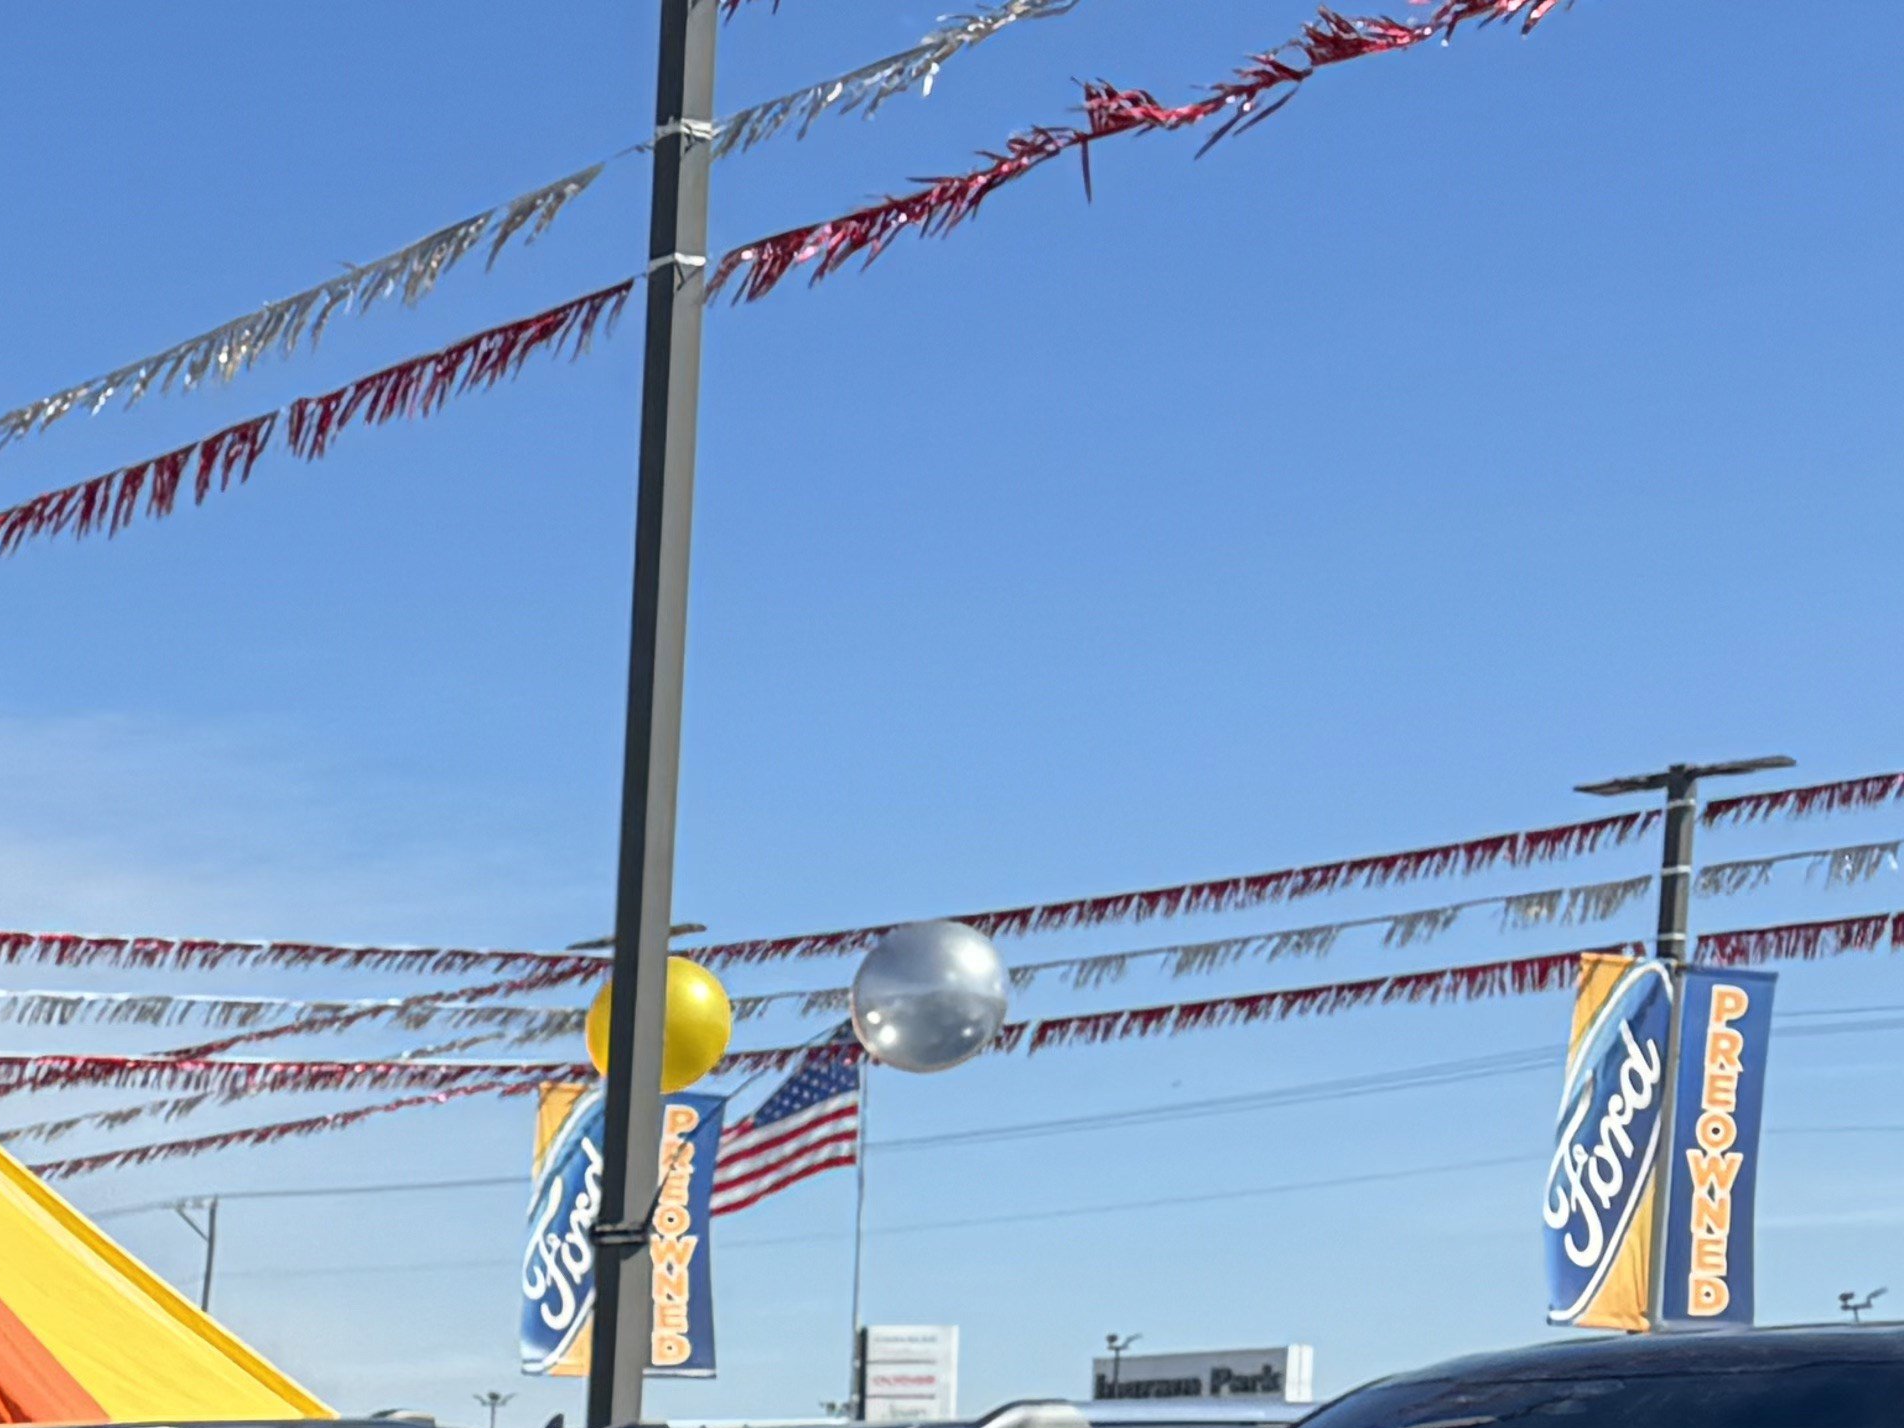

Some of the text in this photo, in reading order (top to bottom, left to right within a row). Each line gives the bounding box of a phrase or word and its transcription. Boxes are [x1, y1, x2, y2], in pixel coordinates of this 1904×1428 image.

[1543, 1018, 1660, 1267] Ford
[1686, 985, 1748, 1316] PREOWNED
[1209, 1364, 1284, 1396] Park
